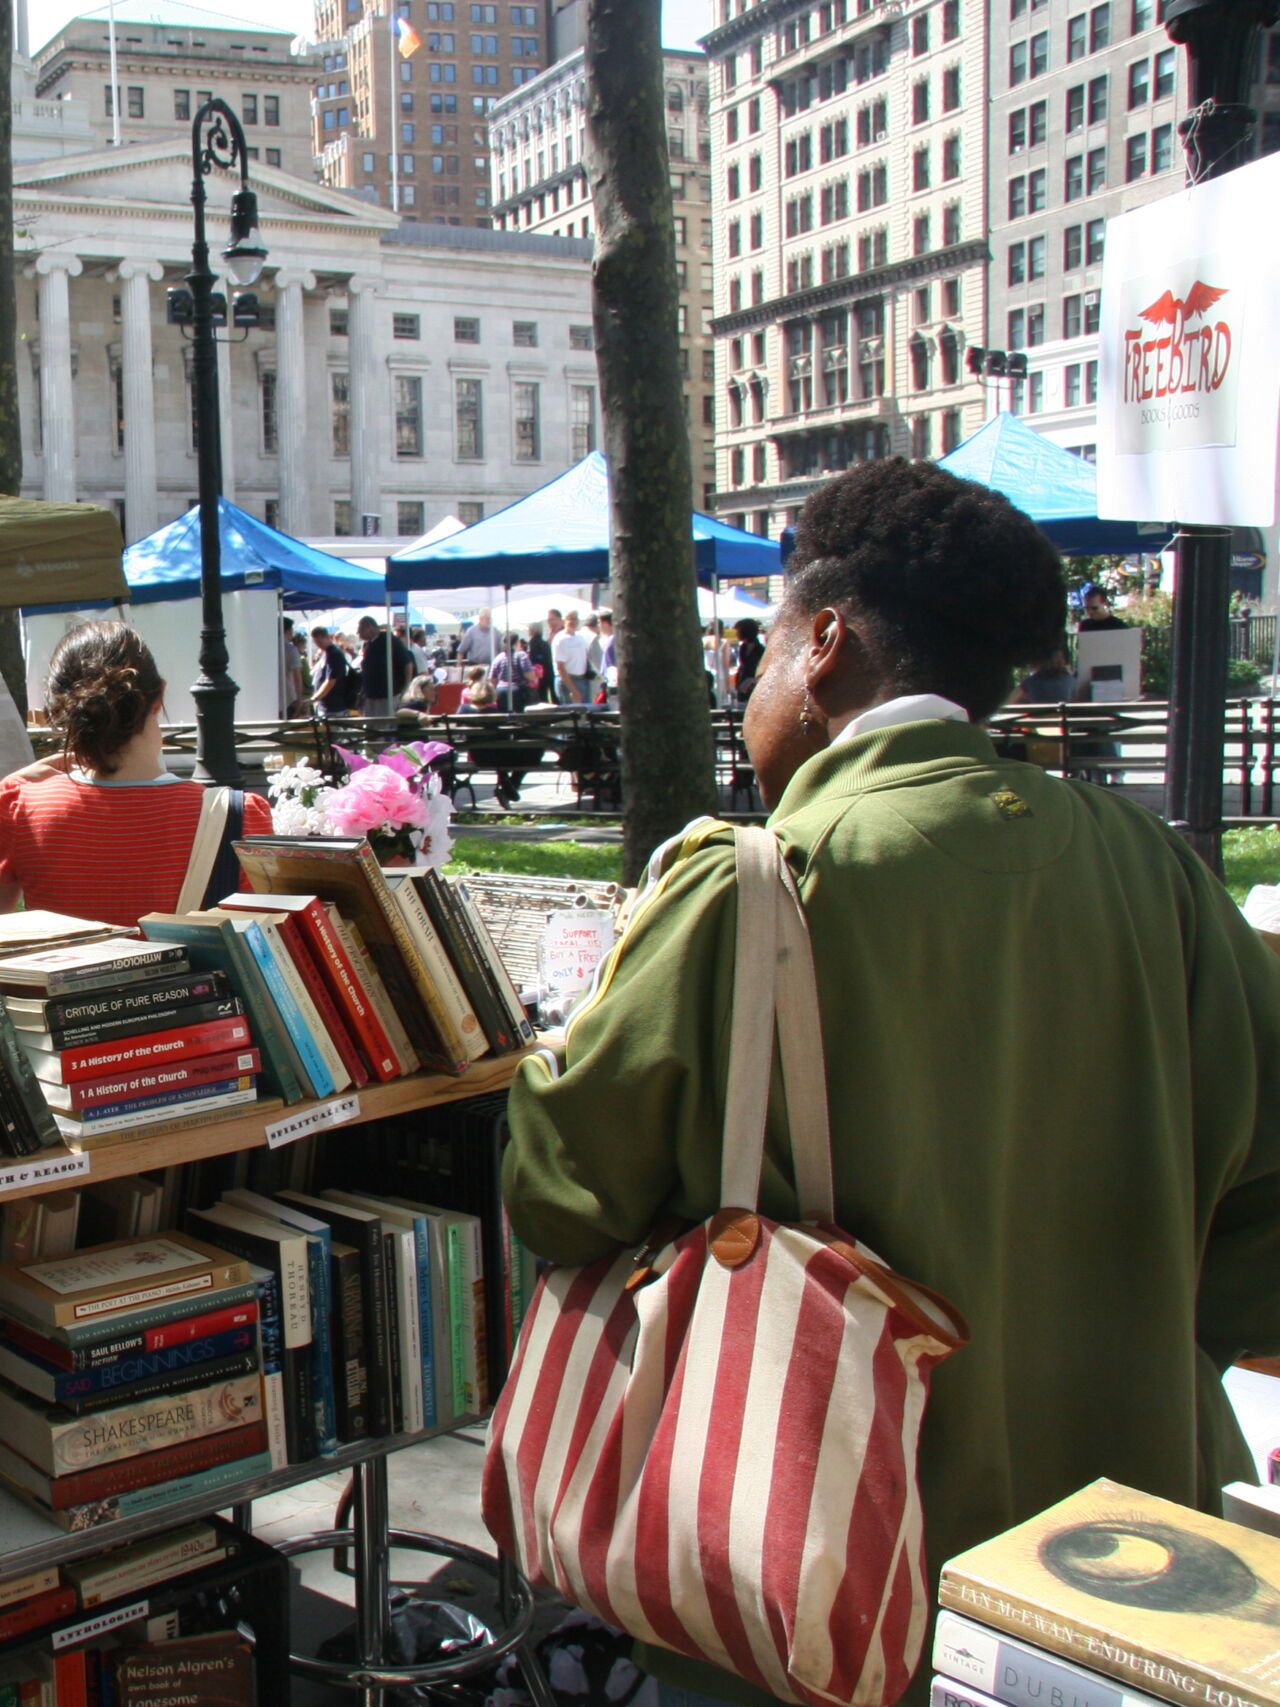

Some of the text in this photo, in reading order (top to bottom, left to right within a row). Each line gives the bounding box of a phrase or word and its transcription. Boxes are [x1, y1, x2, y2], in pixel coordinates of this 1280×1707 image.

[1141, 403, 1200, 425] BOOKS GOODS
[111, 952, 162, 969] MYTHOLOGY
[317, 926, 338, 959] History
[333, 957, 343, 969] of
[338, 968, 351, 985] the
[346, 984, 366, 1016] Church
[64, 988, 189, 1020] CRITIQUE OF PURE REASON
[88, 1052, 122, 1067] History
[152, 1039, 184, 1053] Church
[95, 1081, 128, 1096] History
[140, 1075, 156, 1085] the
[157, 1069, 187, 1083] Church
[137, 1096, 167, 1107] PROBLEM
[33, 1161, 85, 1177] REASON
[287, 1261, 297, 1330] THOREAU
[90, 1337, 142, 1358] SAUL BELLOW'S
[90, 1354, 118, 1366] FICTION
[100, 1338, 216, 1389] BEGINNINGS
[65, 1377, 93, 1396] SAID
[423, 1361, 433, 1415] TORONTO
[82, 1403, 197, 1450] SHAKESPEARE
[58, 1606, 145, 1643] ANTHOLOGIES
[958, 1584, 992, 1608] IAN
[1085, 1636, 1197, 1694] ENDURING
[127, 1657, 235, 1677] Nelson Algren's
[943, 1652, 985, 1676] VINTAGE
[128, 1694, 198, 1707] Lonesome
